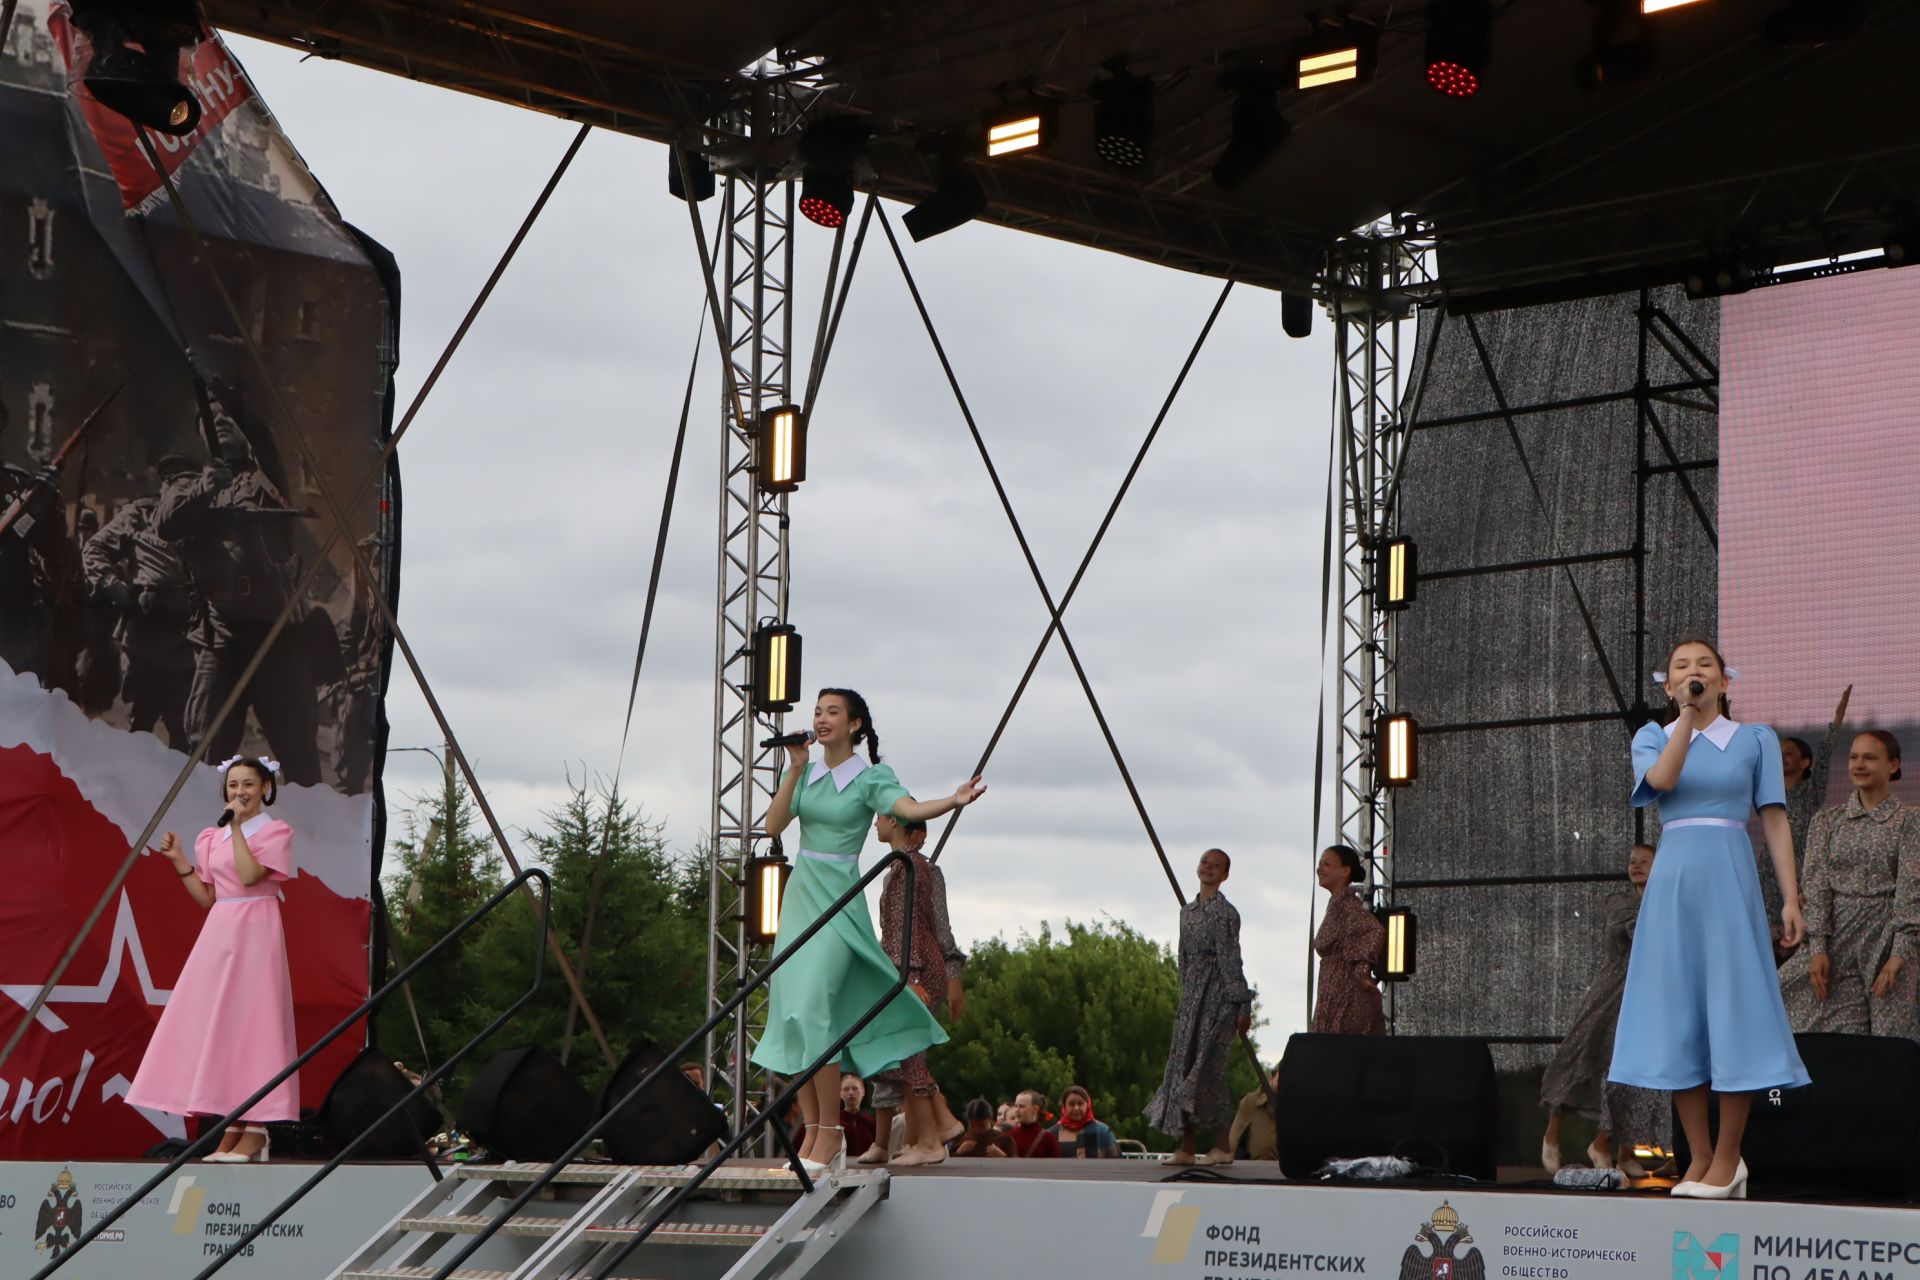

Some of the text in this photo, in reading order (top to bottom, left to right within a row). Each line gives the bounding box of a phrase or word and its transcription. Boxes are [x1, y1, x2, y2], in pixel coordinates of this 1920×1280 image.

[207, 1202, 241, 1218] ФОНД
[205, 1223, 304, 1239] ПРЕЗИДТСКИХ
[1206, 1225, 1260, 1245] ФОНД
[1504, 1225, 1579, 1239] РОССИЙСКОЕ
[203, 1243, 255, 1257] ГРАОВ
[1503, 1245, 1637, 1262] ВОЕННО-ИСТОРИЧЕСКОЕ
[1204, 1250, 1366, 1273] ПРЕЗИДЕНТСКИХ
[1502, 1265, 1569, 1279] ОБЩЕСТВО
